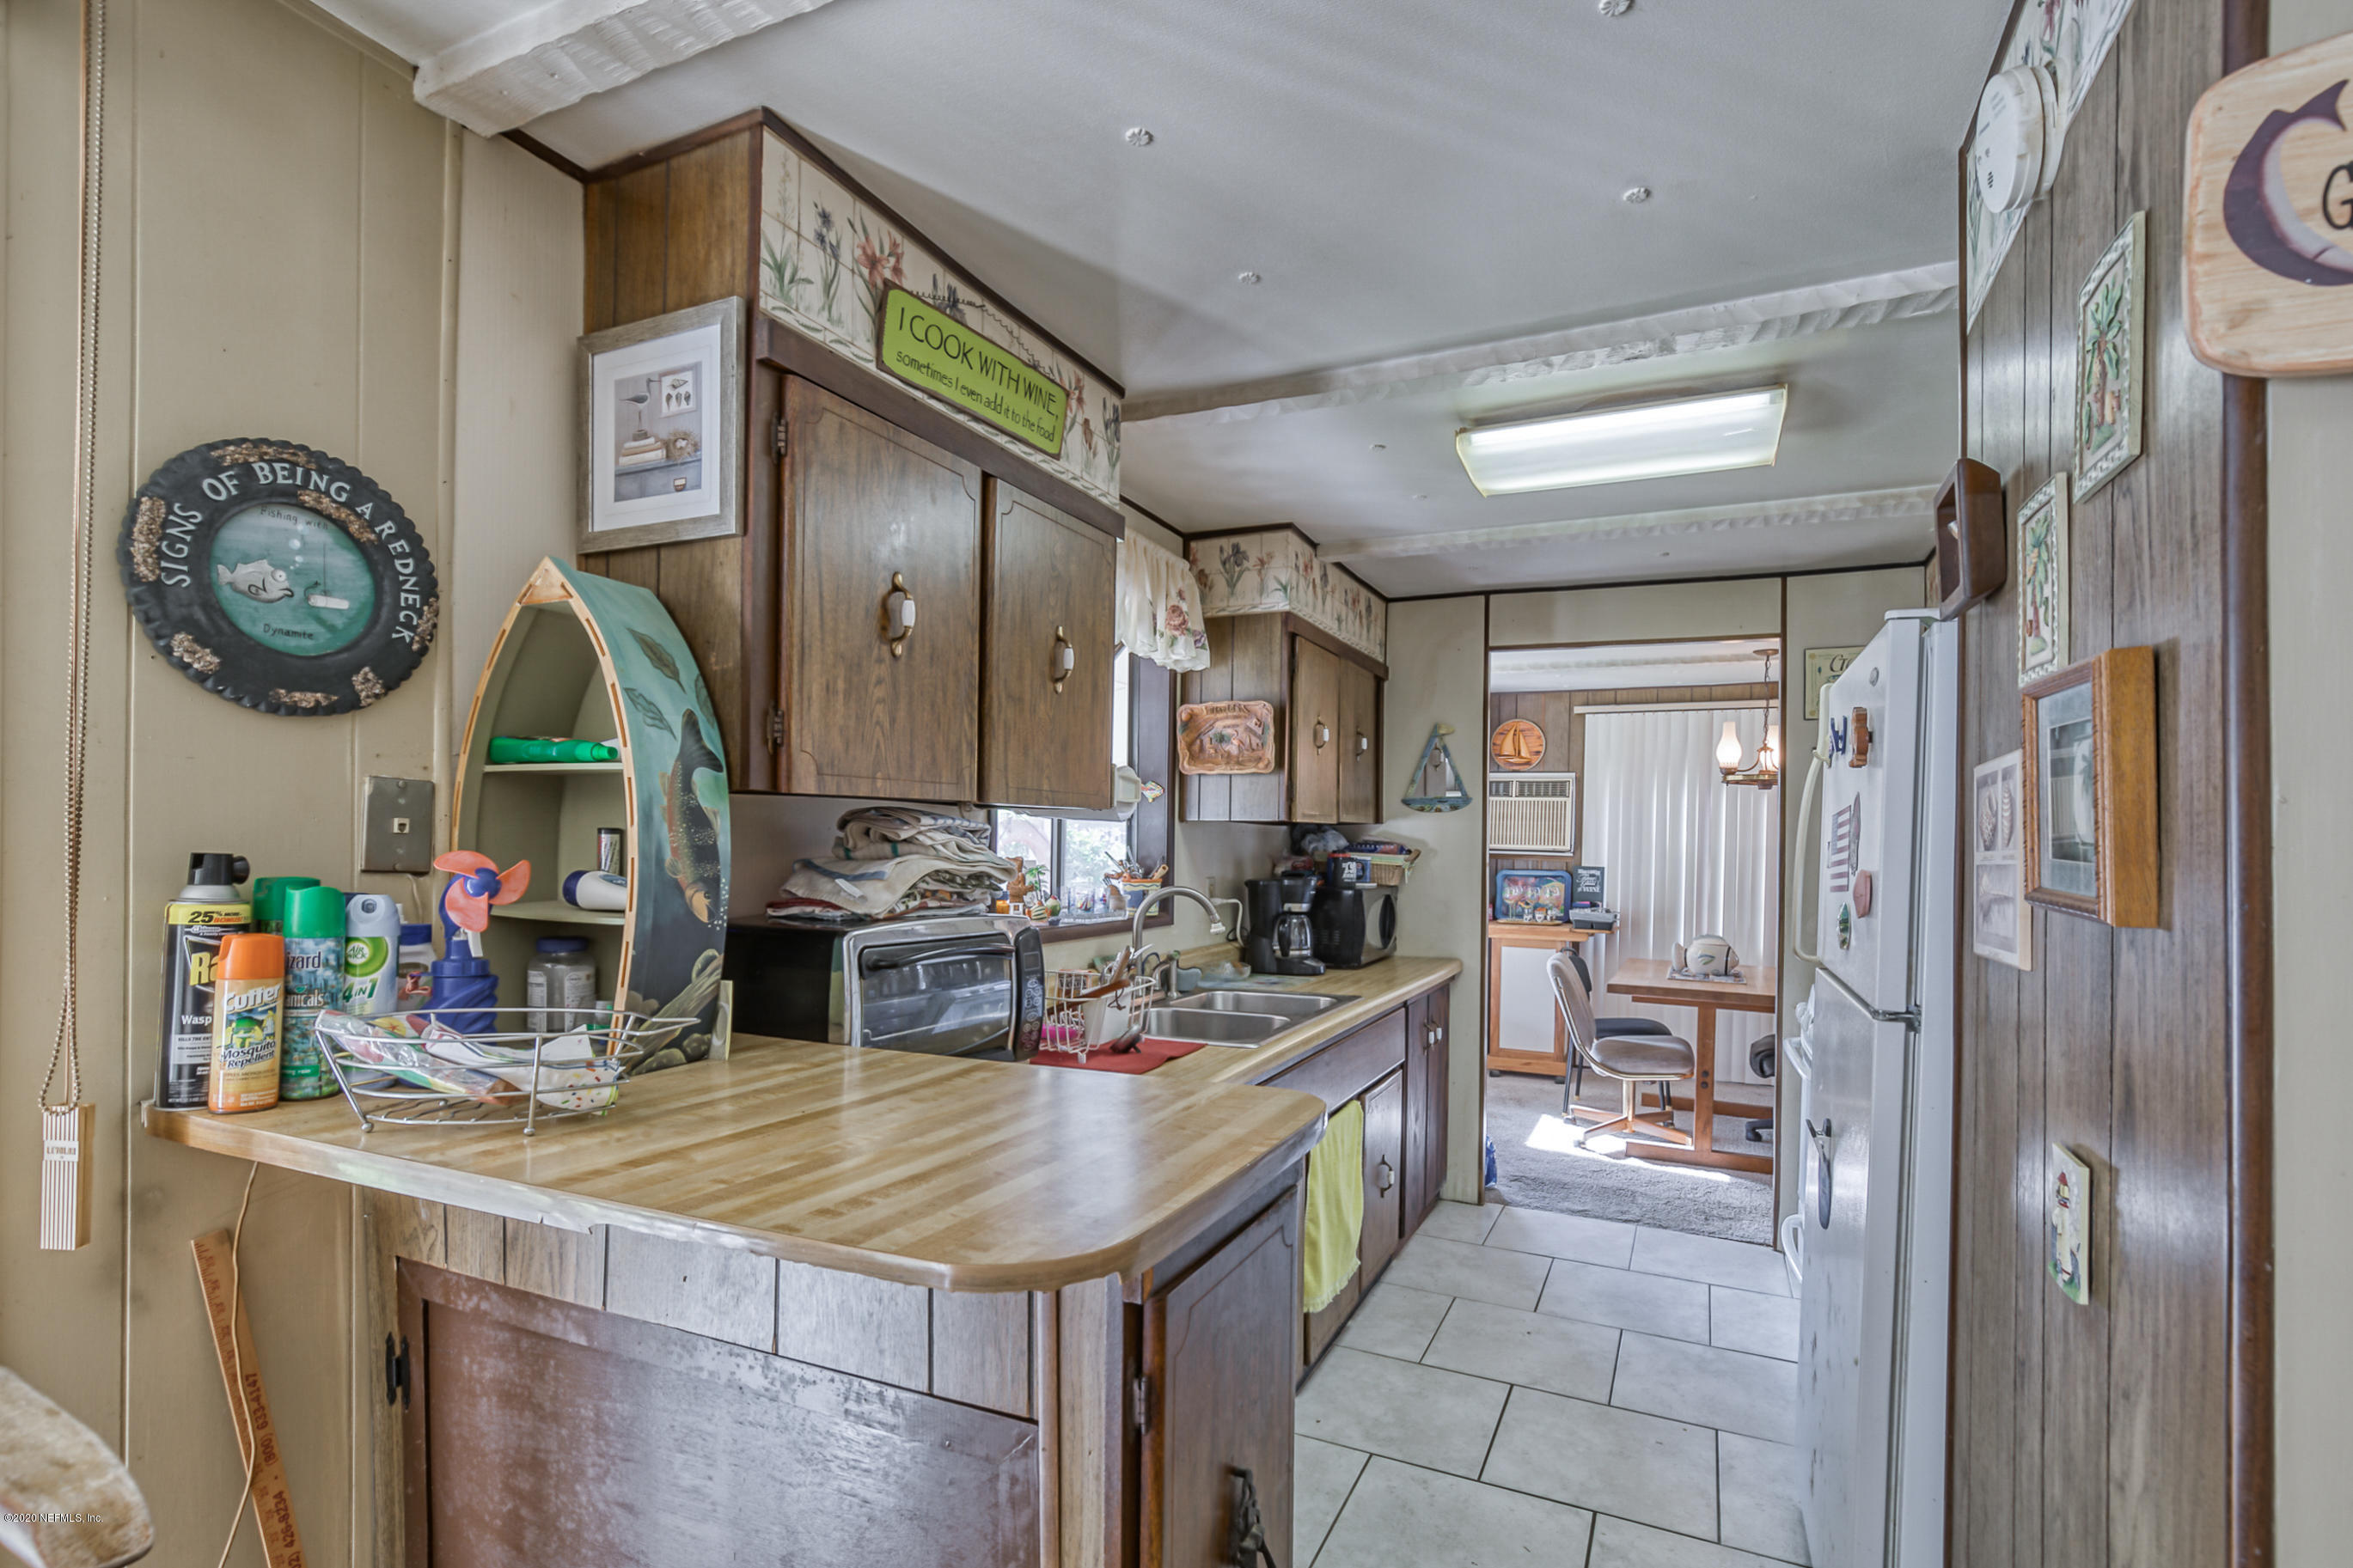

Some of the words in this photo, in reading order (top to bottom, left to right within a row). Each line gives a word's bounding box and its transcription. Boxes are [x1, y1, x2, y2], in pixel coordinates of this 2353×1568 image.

[899, 307, 905, 331] I
[909, 314, 975, 370] COOK
[978, 351, 1021, 394] WITH
[895, 351, 954, 387] sometimes
[960, 385, 983, 405] even
[983, 392, 1004, 415] add
[1004, 406, 1011, 418] it
[1011, 409, 1020, 424] to
[1022, 412, 1036, 432] the
[1035, 416, 1054, 442] food
[260, 505, 298, 525] Fishing
[304, 518, 329, 531] with
[161, 502, 203, 589] SIGNS
[201, 470, 241, 502] OF
[251, 461, 351, 503] BEING
[355, 502, 376, 520] A
[374, 520, 421, 644] REDNECK
[262, 622, 315, 641] Dynamite
[181, 1015, 212, 1027] Wasp
[220, 1040, 276, 1061] Mosquito
[227, 1049, 275, 1069] Repellent
[244, 1373, 269, 1431] 633-4147
[260, 1431, 279, 1467] (800)
[272, 1491, 296, 1549] 426-8234
